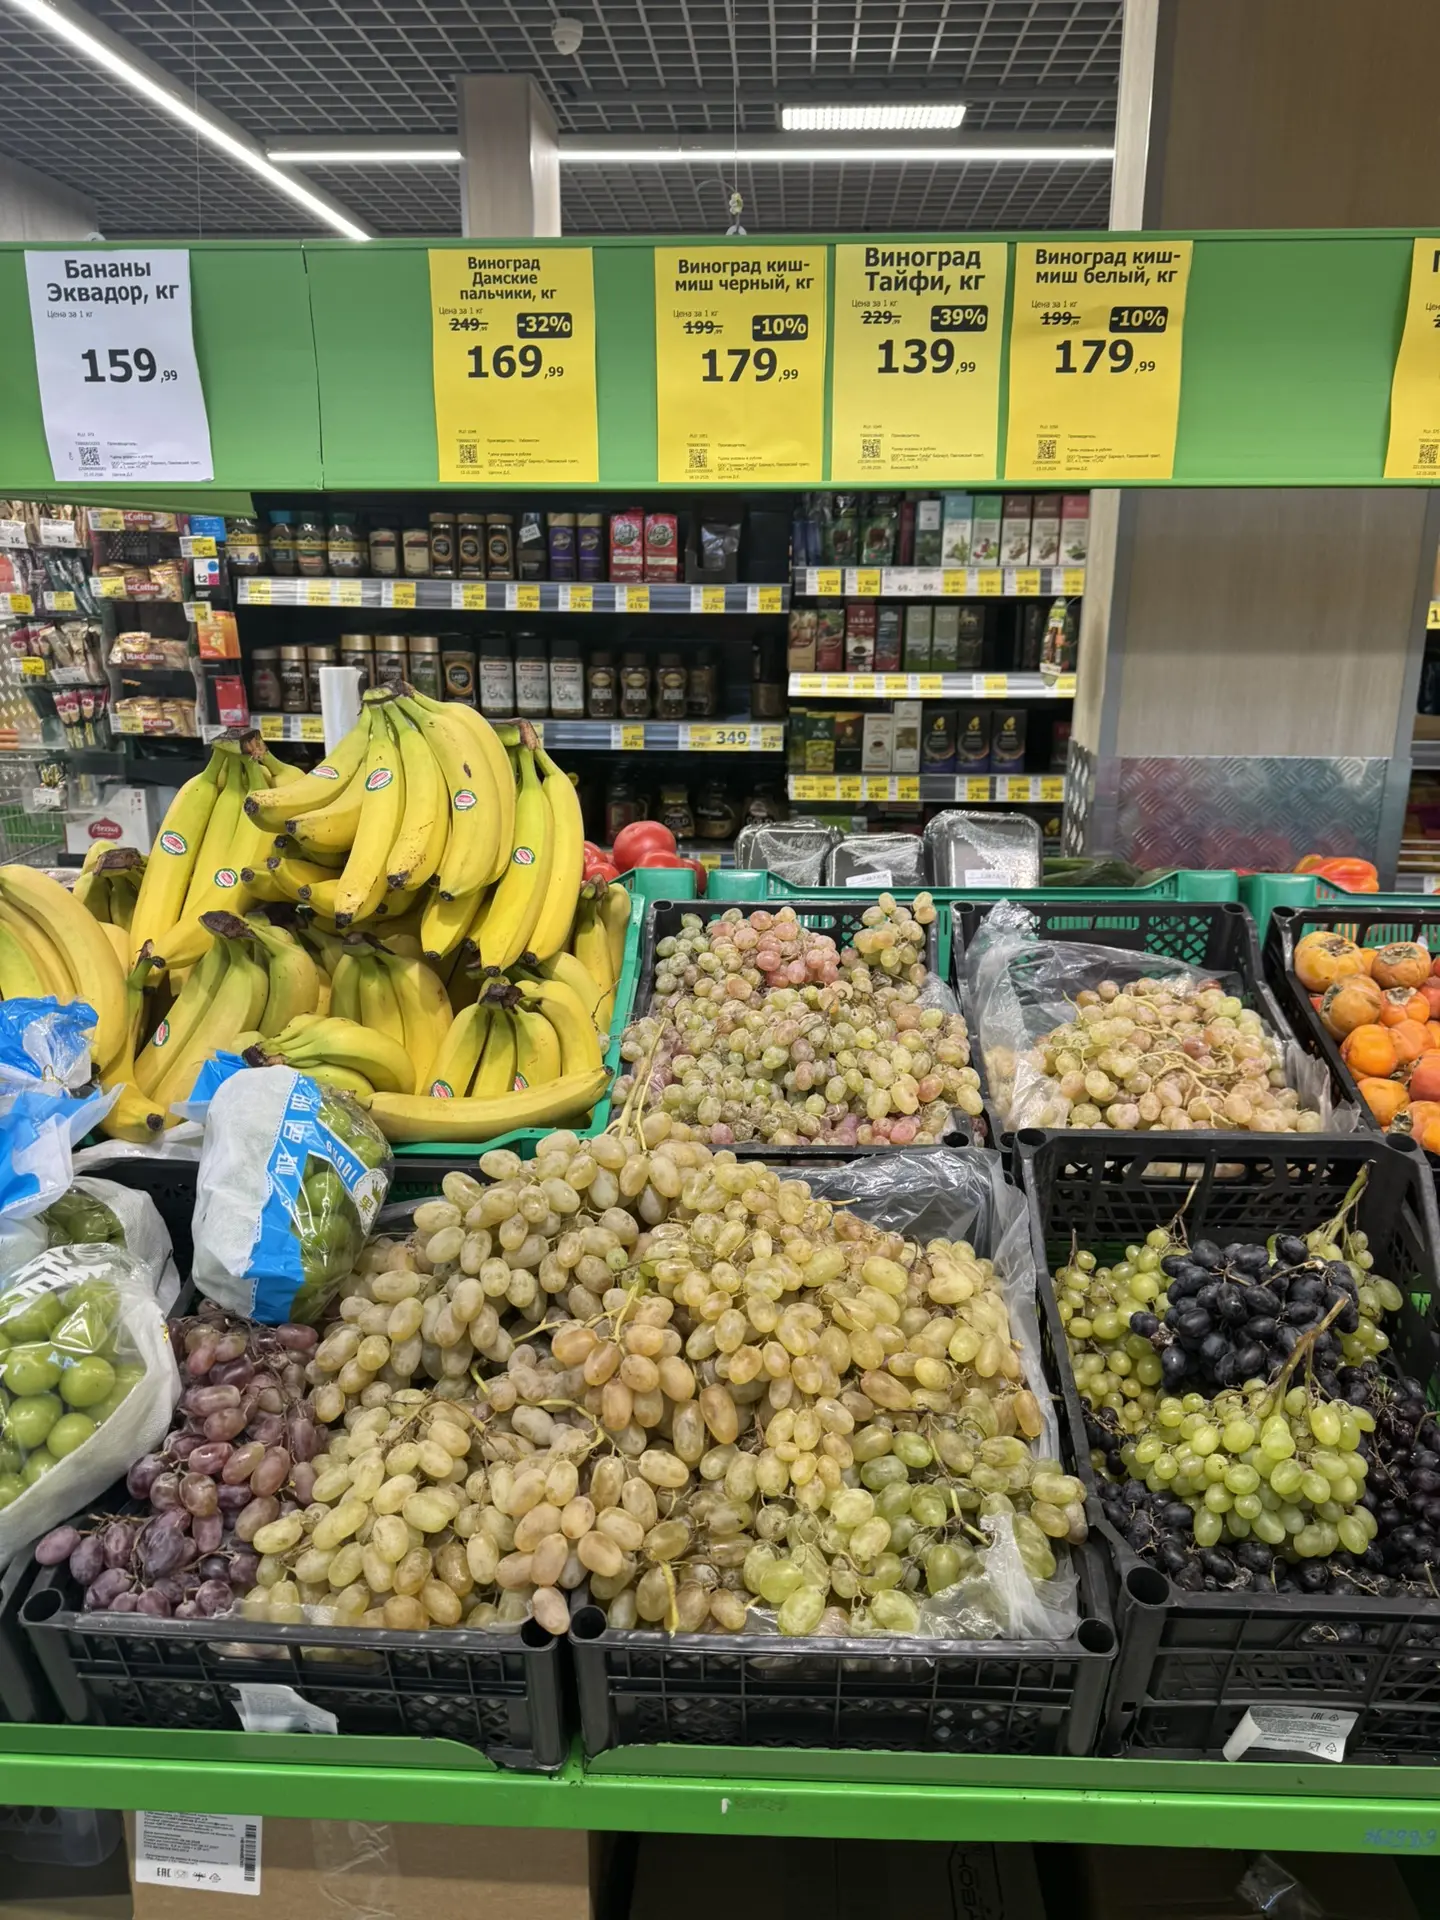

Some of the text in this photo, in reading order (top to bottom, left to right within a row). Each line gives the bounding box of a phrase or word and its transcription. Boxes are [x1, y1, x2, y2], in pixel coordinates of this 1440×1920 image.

[468, 257, 540, 273] Виноград
[679, 260, 809, 276] Виноград киш-
[865, 248, 981, 272] Виноград
[1036, 249, 1180, 269] Виноград киш-
[65, 260, 151, 278] Бананы
[1036, 268, 1178, 286] миш белый, кг
[473, 270, 537, 287] Дамские
[676, 274, 814, 294] миш черный, кг
[865, 271, 985, 296] Тайфи, кг
[47, 283, 179, 305] Эквадор, кг
[460, 285, 556, 301] пальчики, кг
[438, 307, 458, 315] Цена
[851, 299, 871, 308] Цена
[889, 300, 898, 309] кг
[1031, 301, 1050, 309] Цена
[1069, 301, 1078, 309] кг
[47, 310, 67, 320] Цена
[673, 309, 692, 318] Цена
[932, 309, 986, 327] -39%
[1110, 309, 1165, 328] -10%
[517, 316, 572, 334] -32%
[753, 318, 807, 337] -10%
[715, 731, 748, 745] 349
